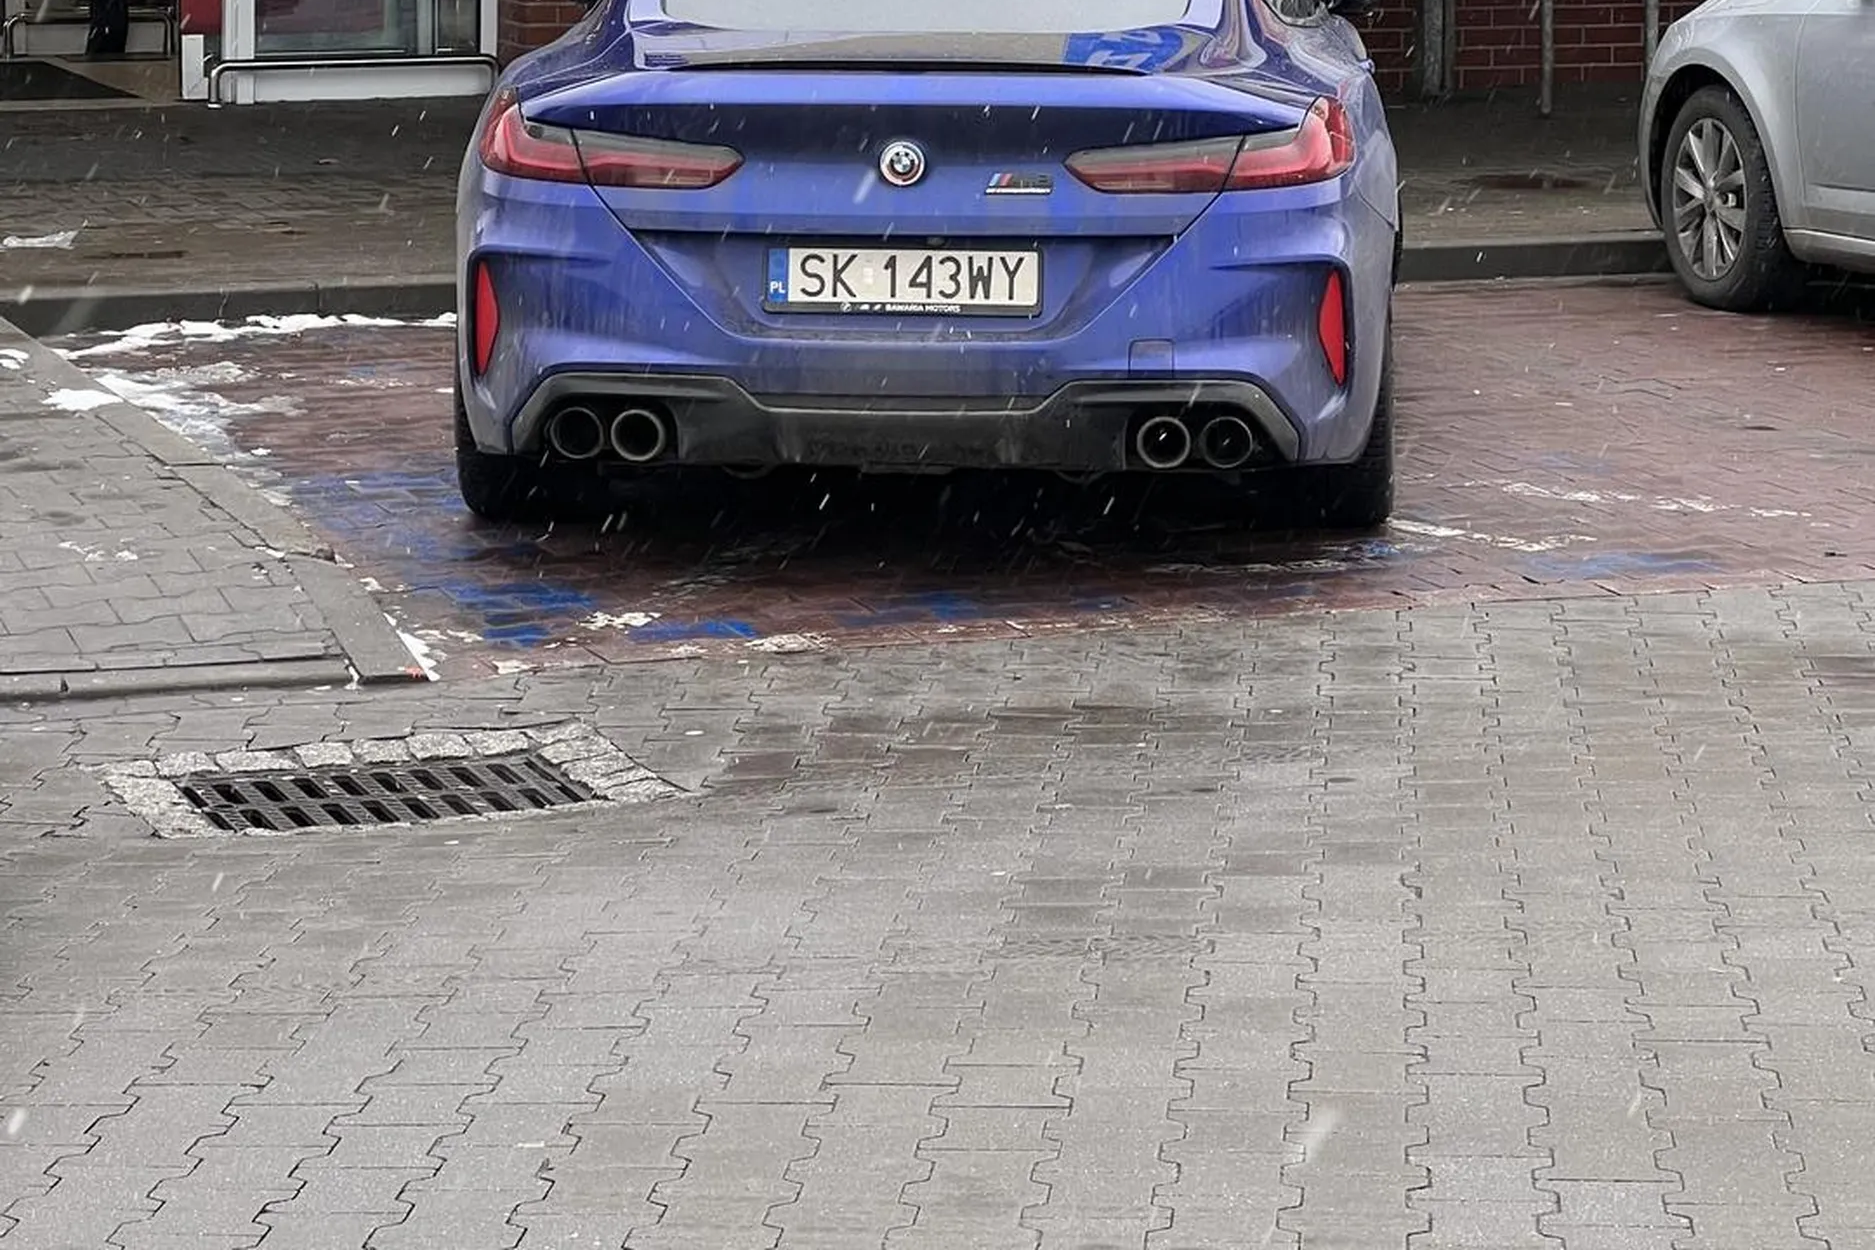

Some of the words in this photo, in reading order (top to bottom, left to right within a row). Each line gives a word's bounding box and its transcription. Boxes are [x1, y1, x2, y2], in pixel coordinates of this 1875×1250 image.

[800, 253, 858, 298] SK
[883, 254, 1025, 300] 143WY
[770, 282, 786, 293] PL
[925, 304, 961, 313] MOTORS
